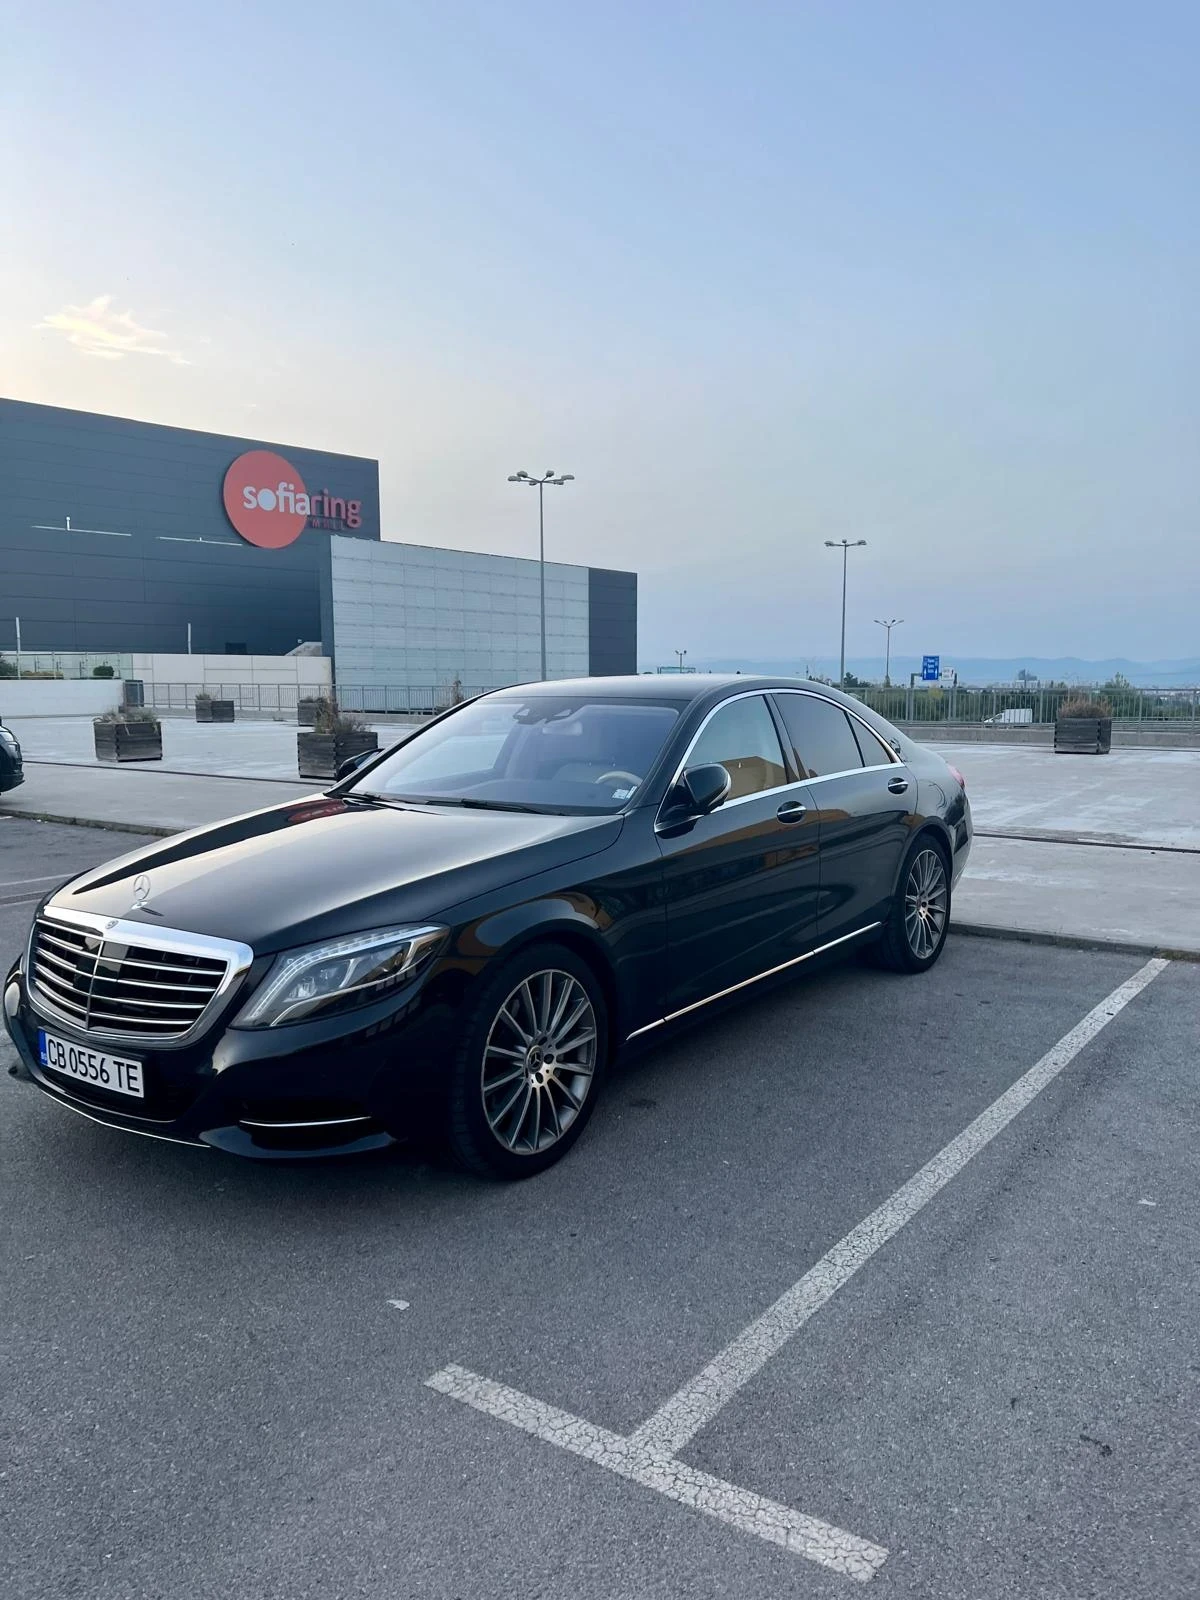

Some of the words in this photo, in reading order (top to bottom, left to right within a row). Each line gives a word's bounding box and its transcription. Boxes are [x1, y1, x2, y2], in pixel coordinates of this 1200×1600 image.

[48, 1039, 66, 1069] CB
[69, 1047, 110, 1084] 0556
[113, 1060, 140, 1092] TE
